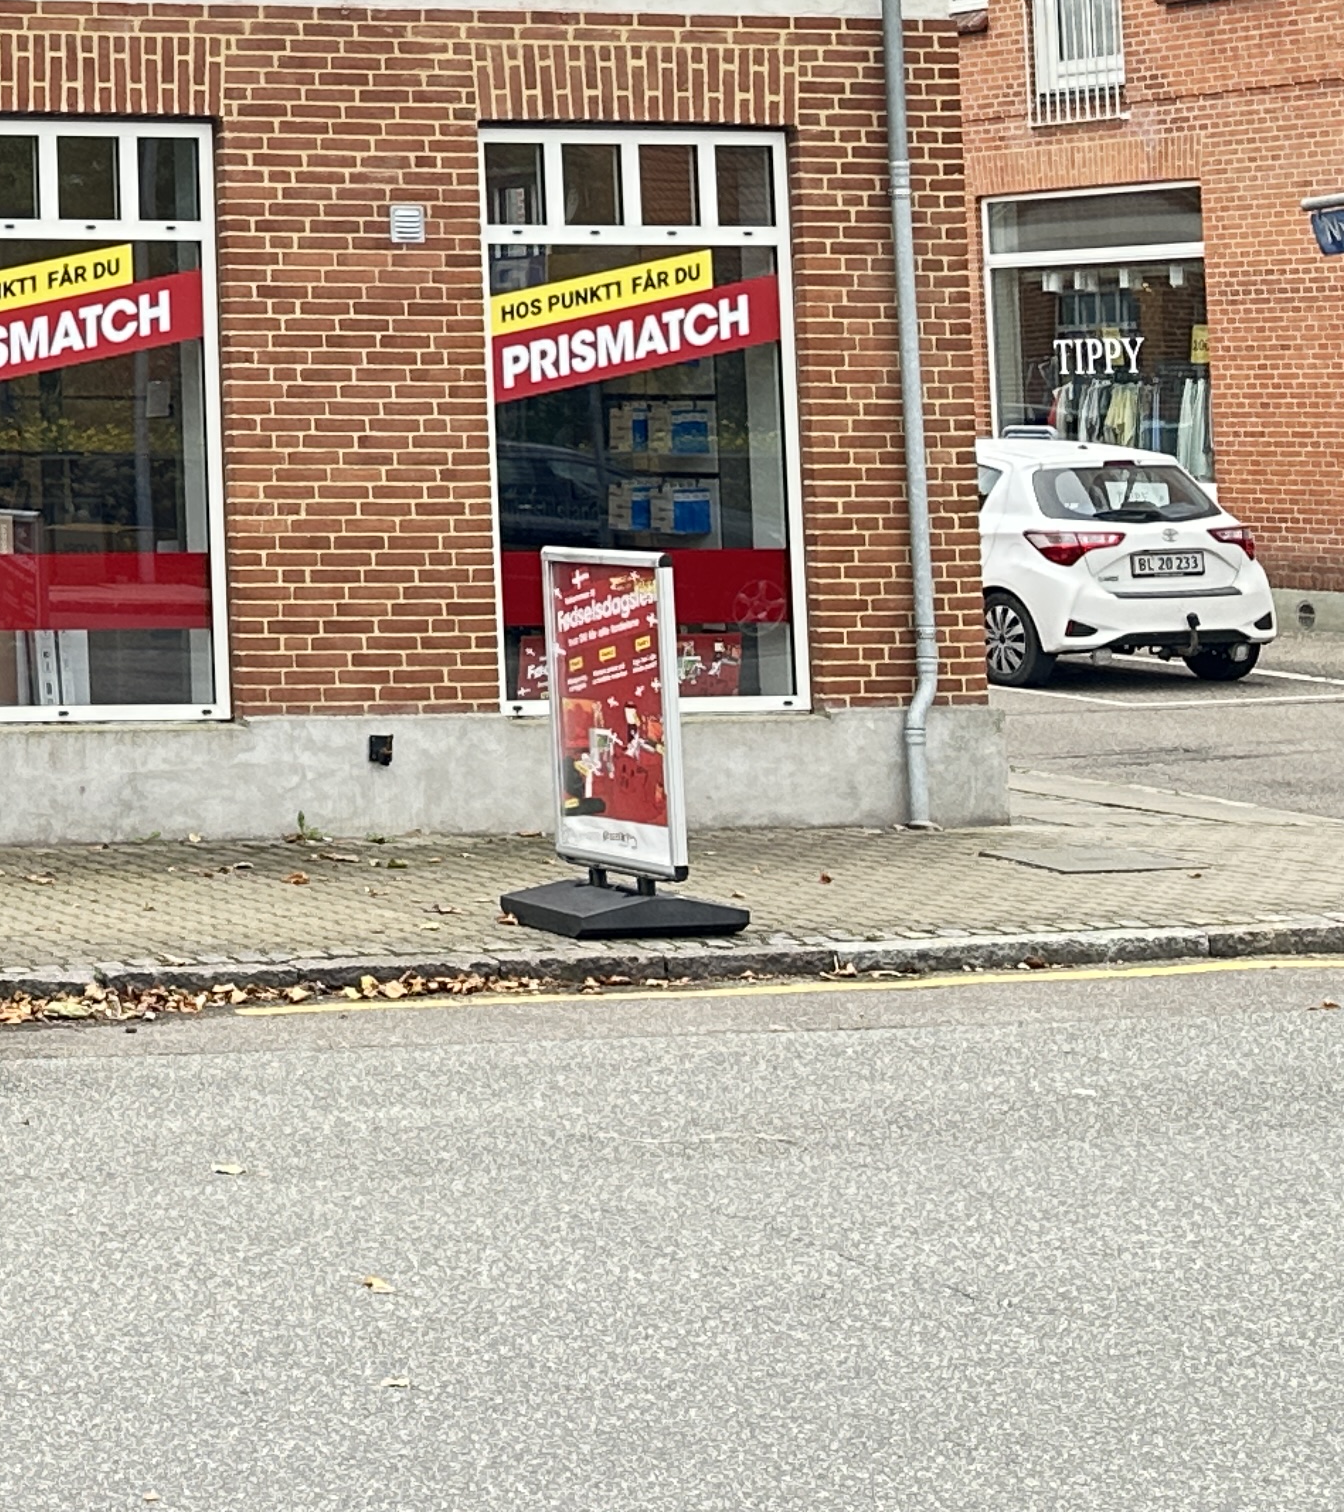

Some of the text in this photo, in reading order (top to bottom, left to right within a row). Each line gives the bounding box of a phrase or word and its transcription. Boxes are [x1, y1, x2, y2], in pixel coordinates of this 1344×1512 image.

[47, 263, 88, 290] FÅR
[93, 258, 121, 281] DU
[501, 263, 701, 324] HOS PUNKT1 FÅR DU
[501, 294, 751, 390] PRISMATCH
[1052, 337, 1145, 375] TIPPY
[1138, 555, 1198, 572] BL 20 233
